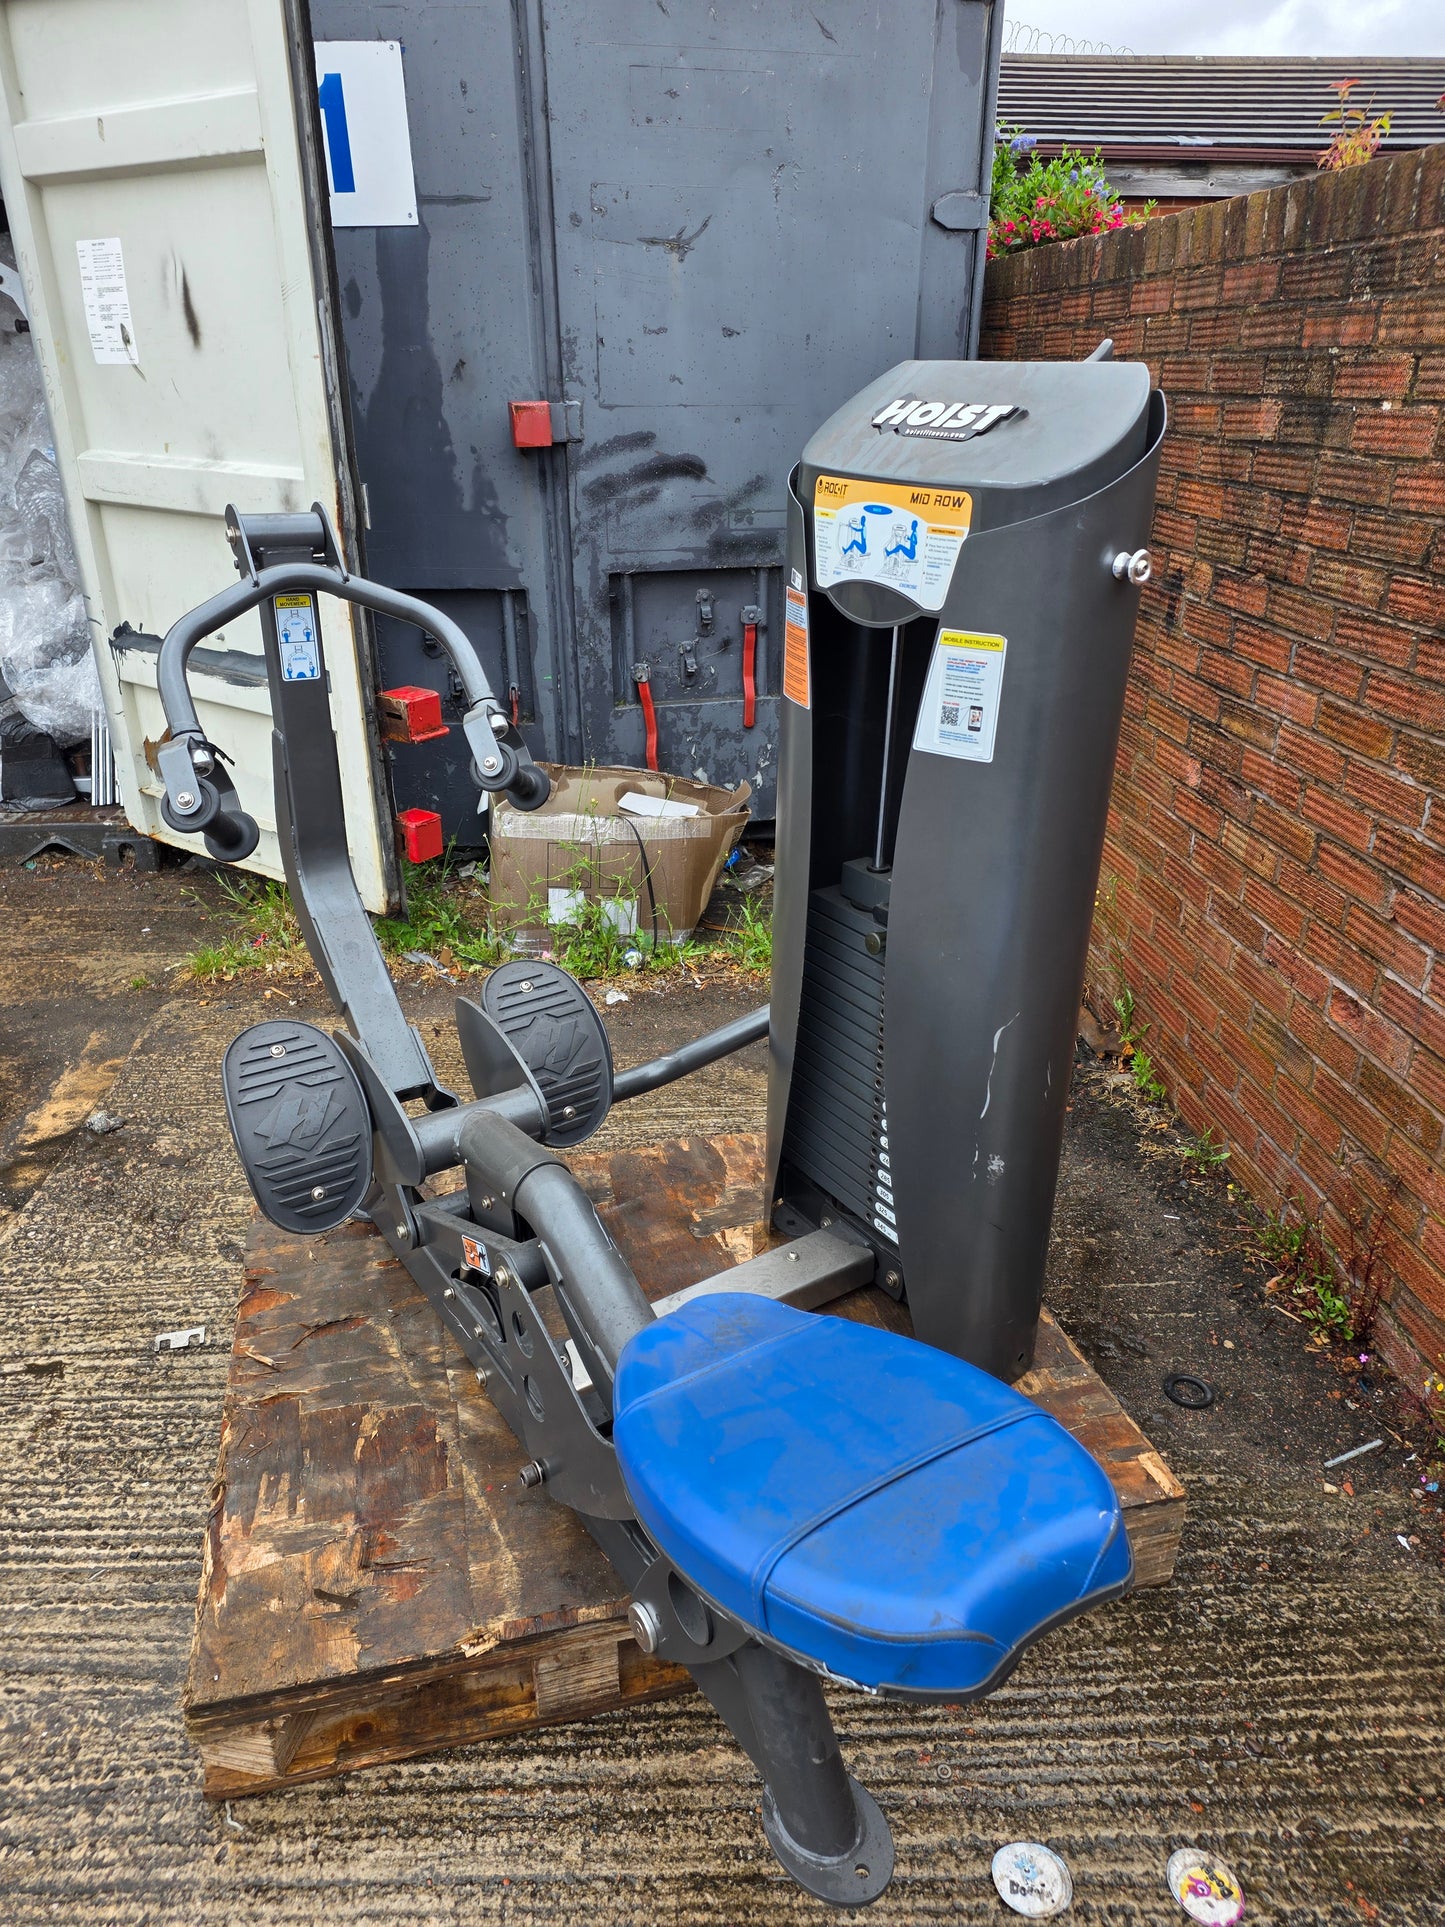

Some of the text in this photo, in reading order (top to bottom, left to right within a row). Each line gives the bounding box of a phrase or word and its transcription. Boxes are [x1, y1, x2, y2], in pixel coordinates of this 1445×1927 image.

[873, 400, 1014, 430] HOIST
[905, 428, 966, 439] hoistfitness.com
[910, 492, 966, 508] MID ROW
[943, 636, 1000, 648] MOBILE INSTRUCTION
[880, 1172, 891, 1184] 285
[880, 1189, 890, 1200] 305
[878, 1205, 888, 1216] 325
